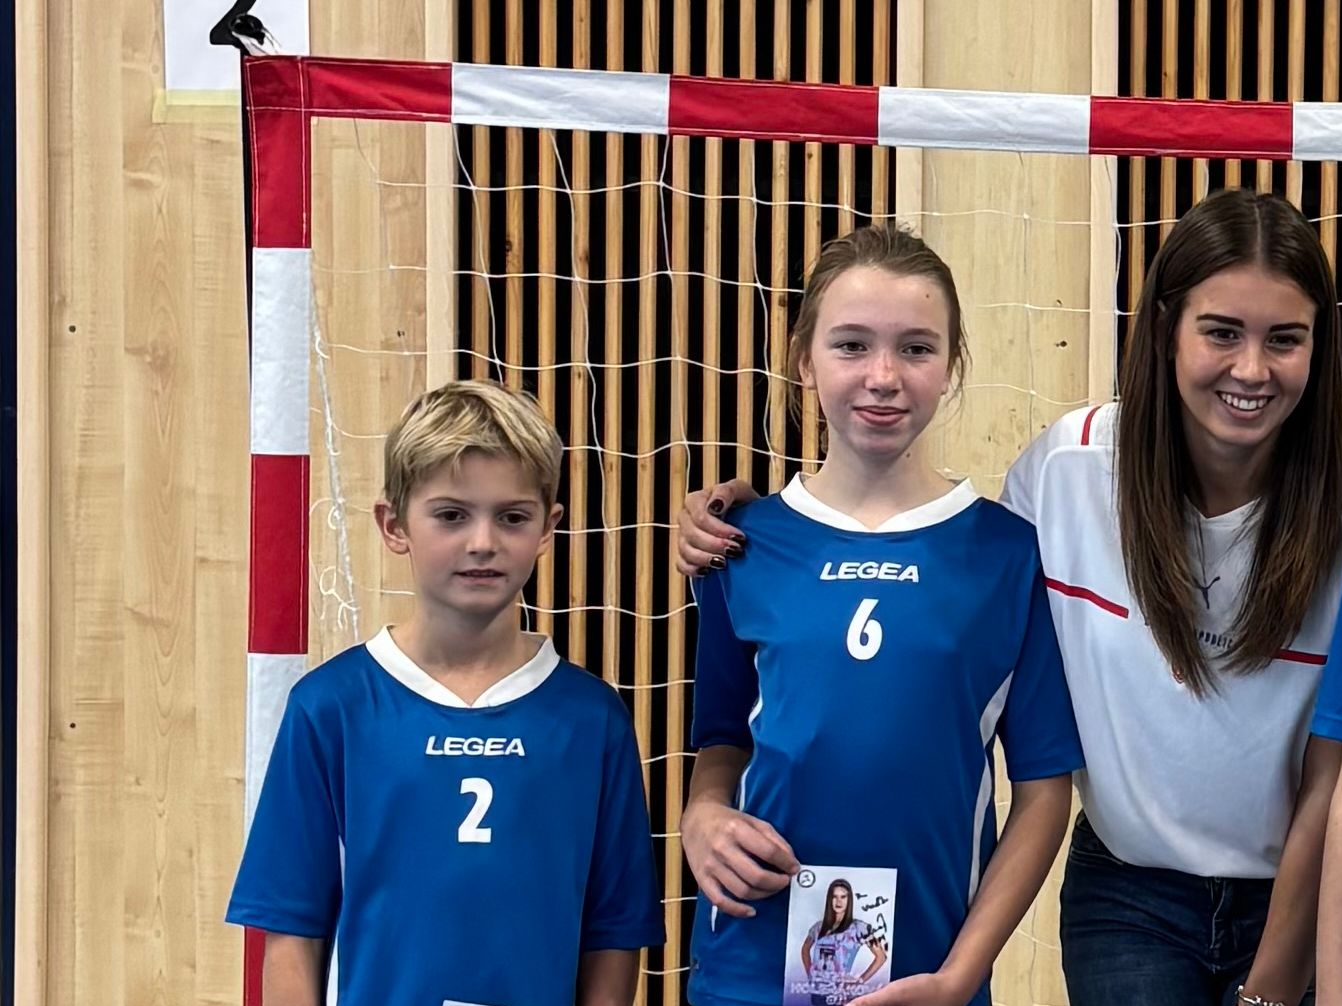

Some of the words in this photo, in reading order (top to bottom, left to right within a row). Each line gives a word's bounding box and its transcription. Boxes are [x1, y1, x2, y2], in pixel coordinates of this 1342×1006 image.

[820, 561, 919, 583] LEGEA
[846, 598, 883, 661] 6
[425, 735, 525, 756] LEGEA
[458, 777, 493, 843] 2
